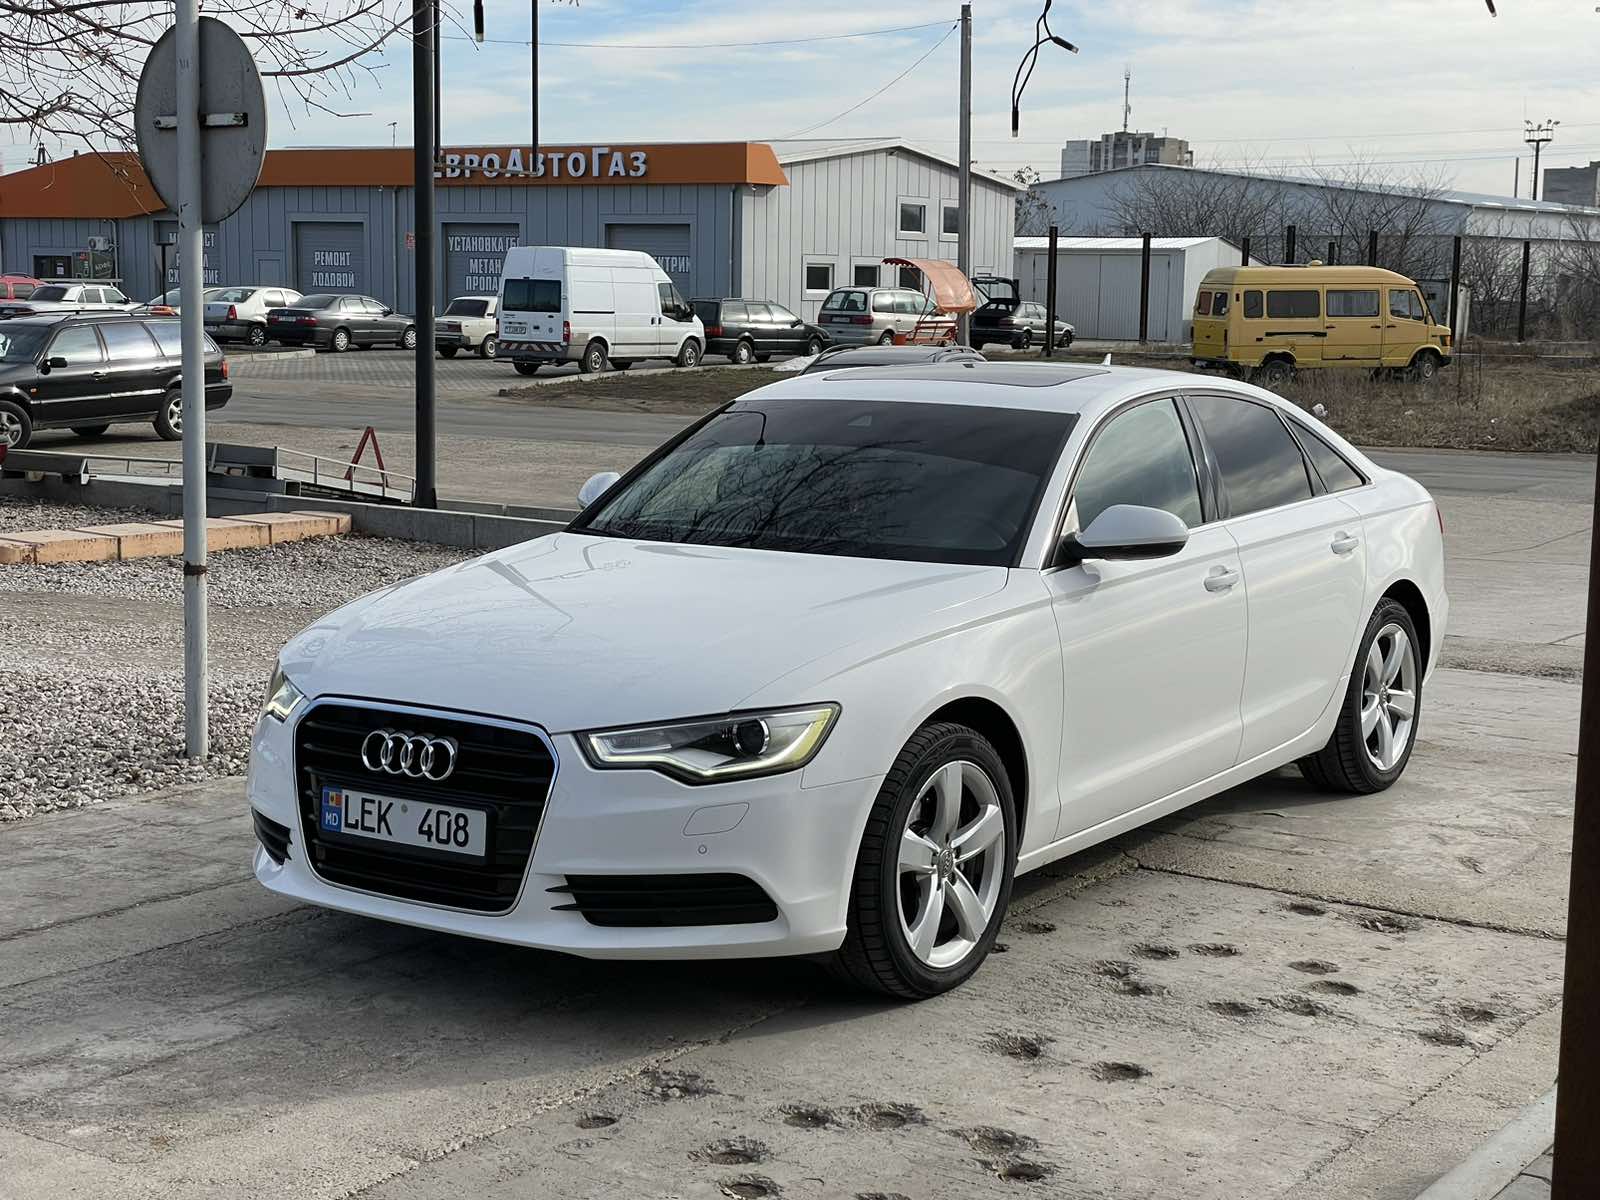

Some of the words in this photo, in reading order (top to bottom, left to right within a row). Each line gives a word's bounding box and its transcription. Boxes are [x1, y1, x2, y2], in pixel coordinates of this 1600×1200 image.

[448, 236, 504, 252] УСТАНОВКА
[314, 252, 351, 266] РЕМОНТ
[469, 258, 501, 274] МЕТАН
[312, 270, 355, 288] ХОДОВОЙ
[466, 276, 501, 291] ПРОПА
[325, 812, 339, 826] MD
[344, 795, 394, 836] LEK
[418, 808, 469, 847] 408
